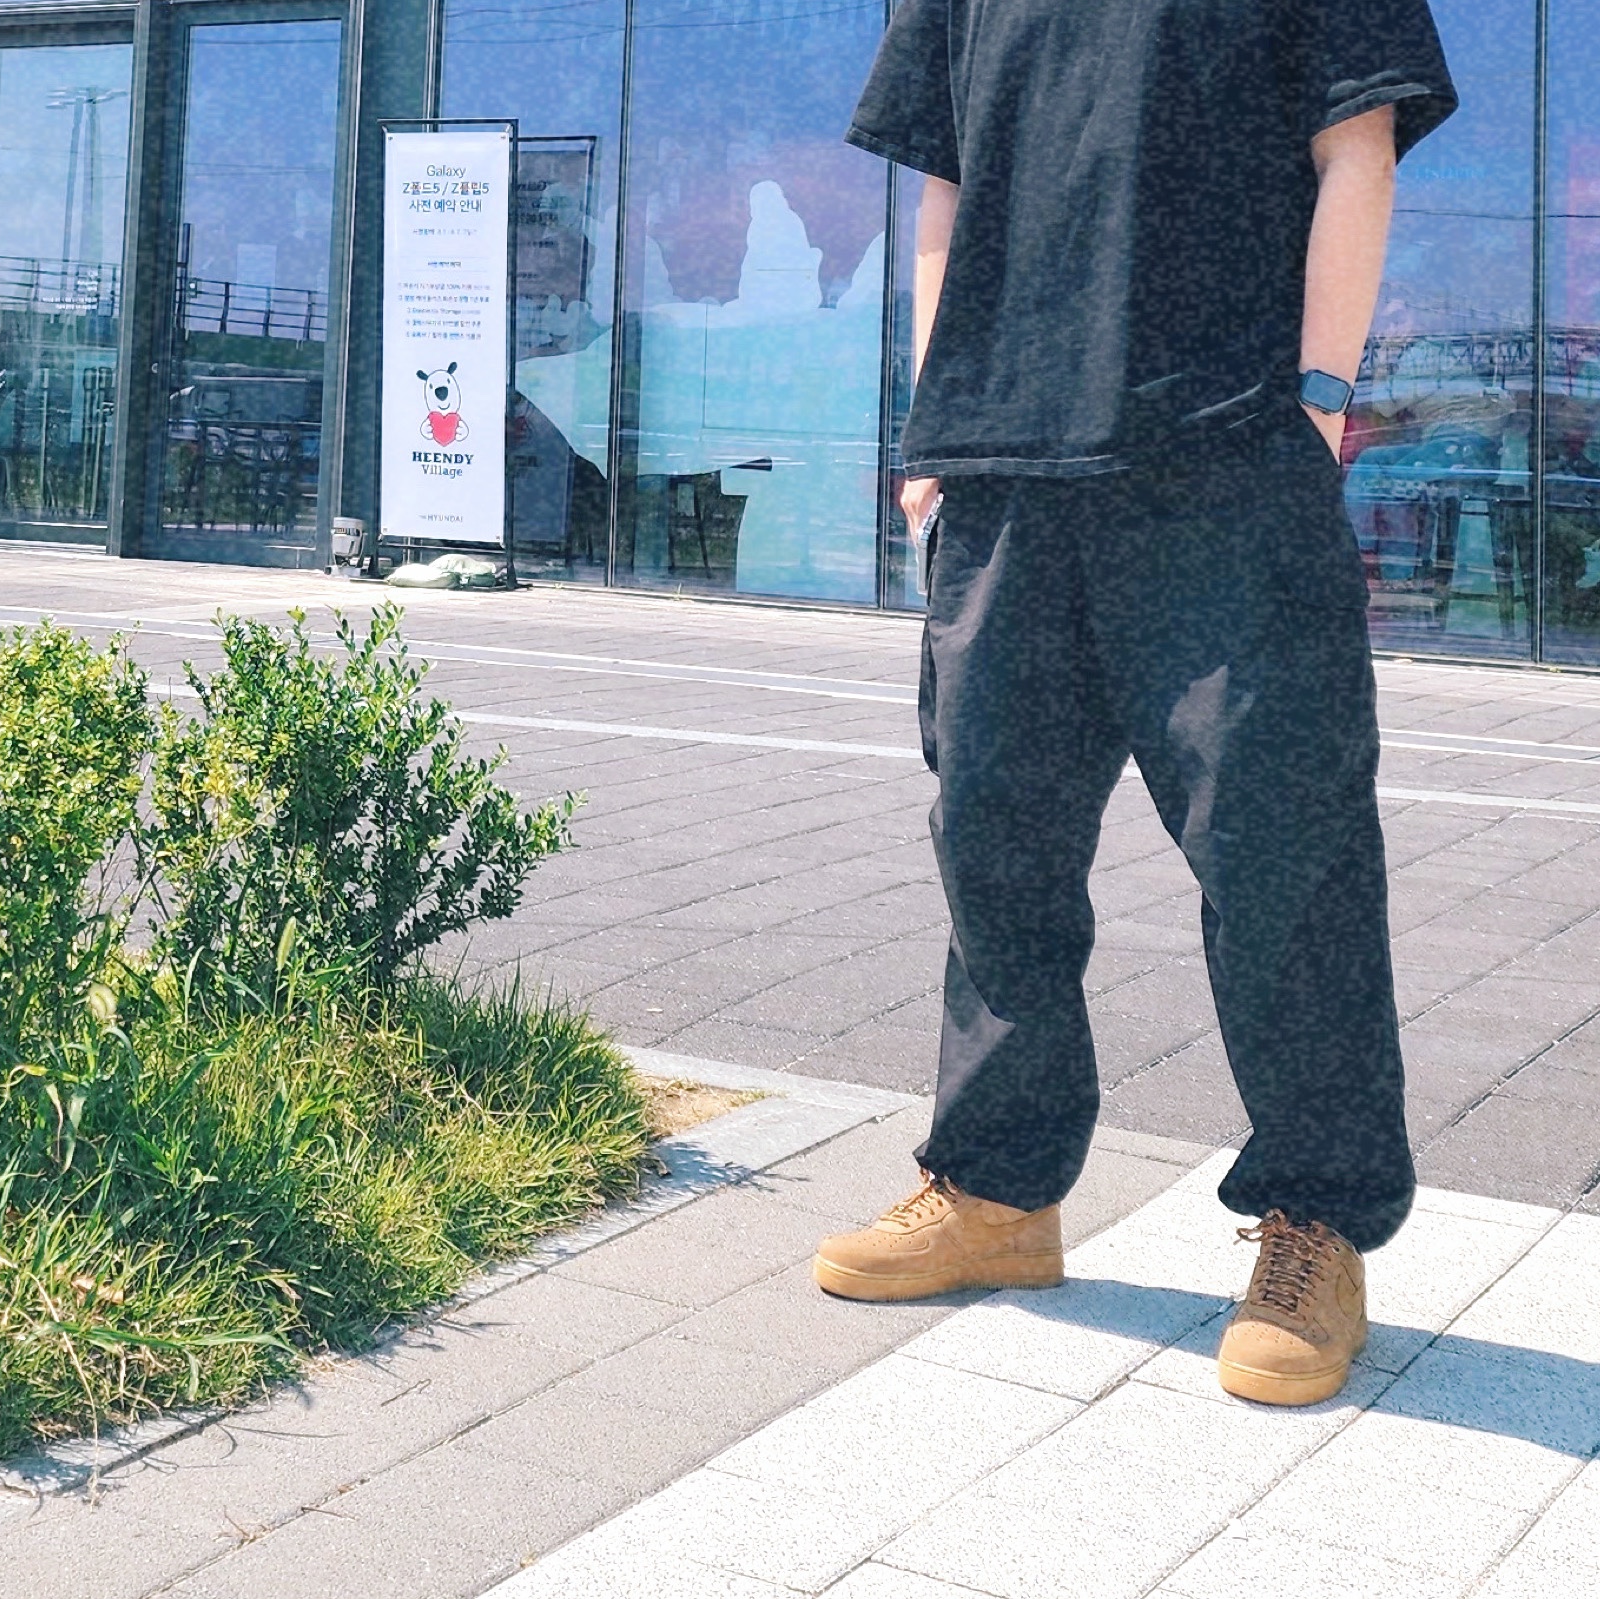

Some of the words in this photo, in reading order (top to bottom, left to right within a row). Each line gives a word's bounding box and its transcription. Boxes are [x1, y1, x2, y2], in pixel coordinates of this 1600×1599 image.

[426, 165, 467, 179] Galaxy
[409, 199, 432, 213] 사전
[433, 199, 457, 213] 예약
[460, 199, 482, 213] 안내
[412, 451, 475, 465] HEENDY
[421, 464, 463, 480] Village
